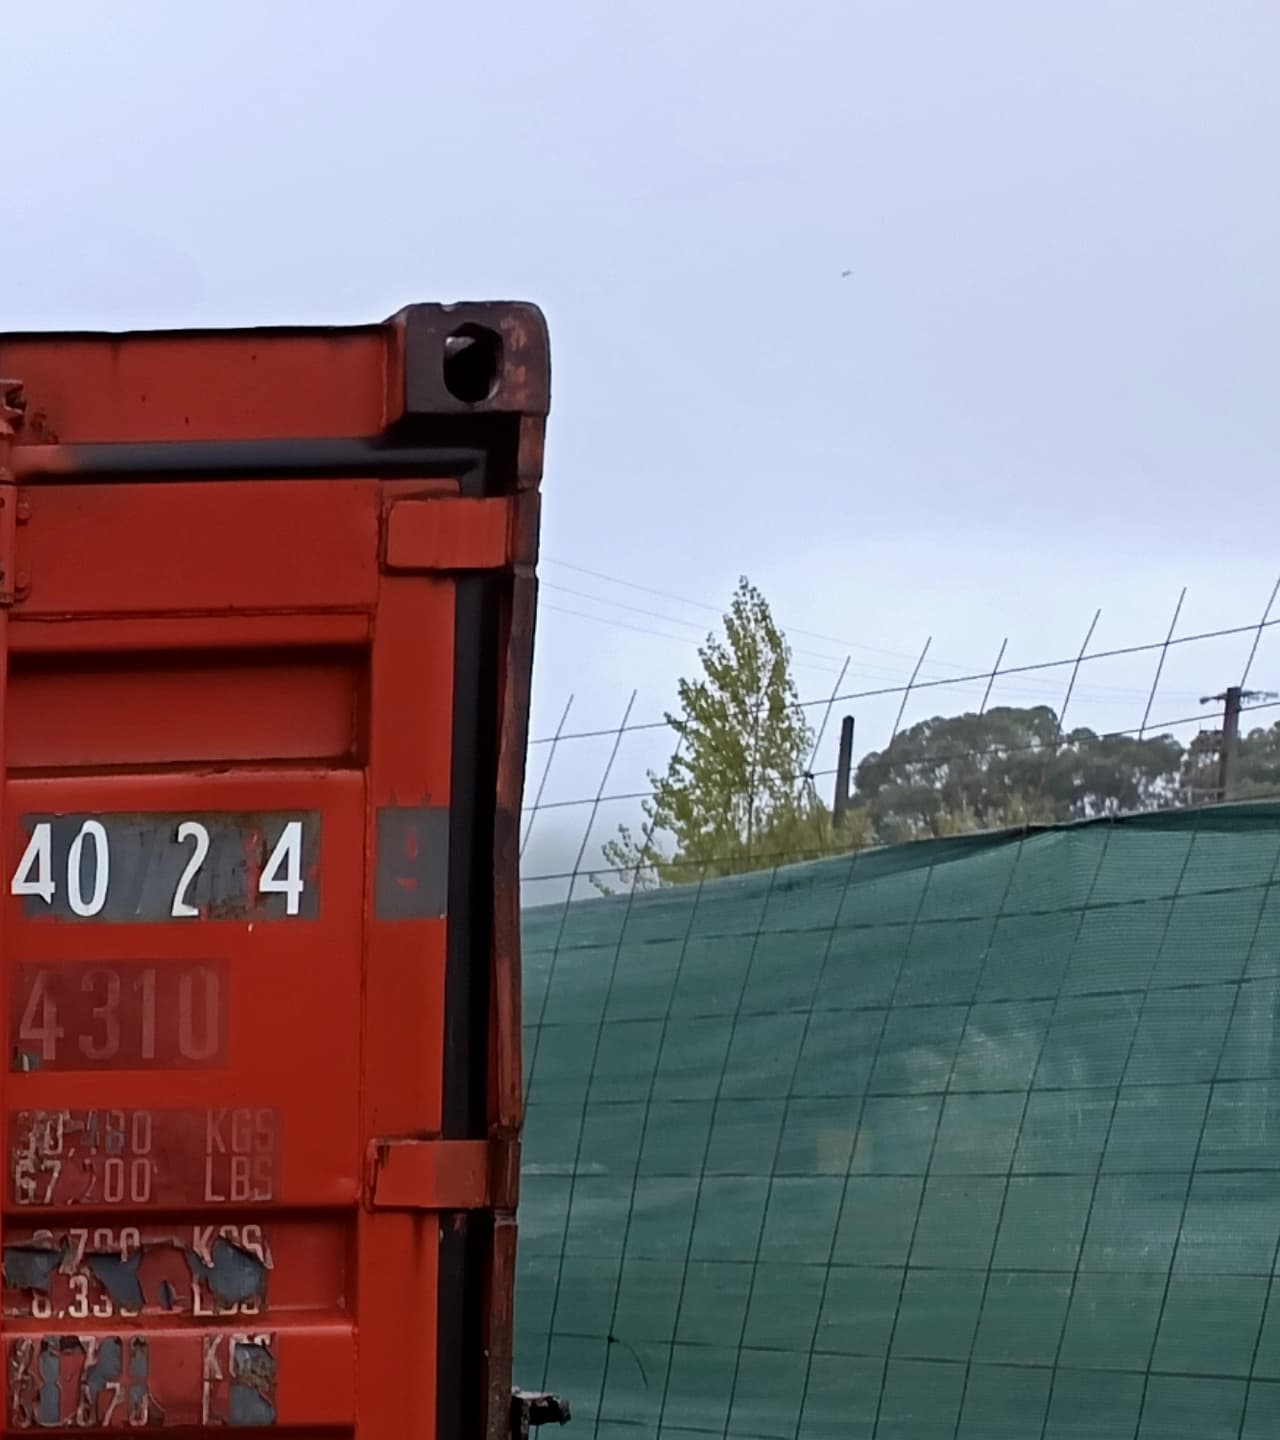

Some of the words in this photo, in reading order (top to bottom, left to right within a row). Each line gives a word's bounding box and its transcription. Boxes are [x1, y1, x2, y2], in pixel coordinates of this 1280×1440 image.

[19, 967, 220, 1062] 4310
[205, 1108, 274, 1155] KGS
[204, 1155, 273, 1202] LBS
